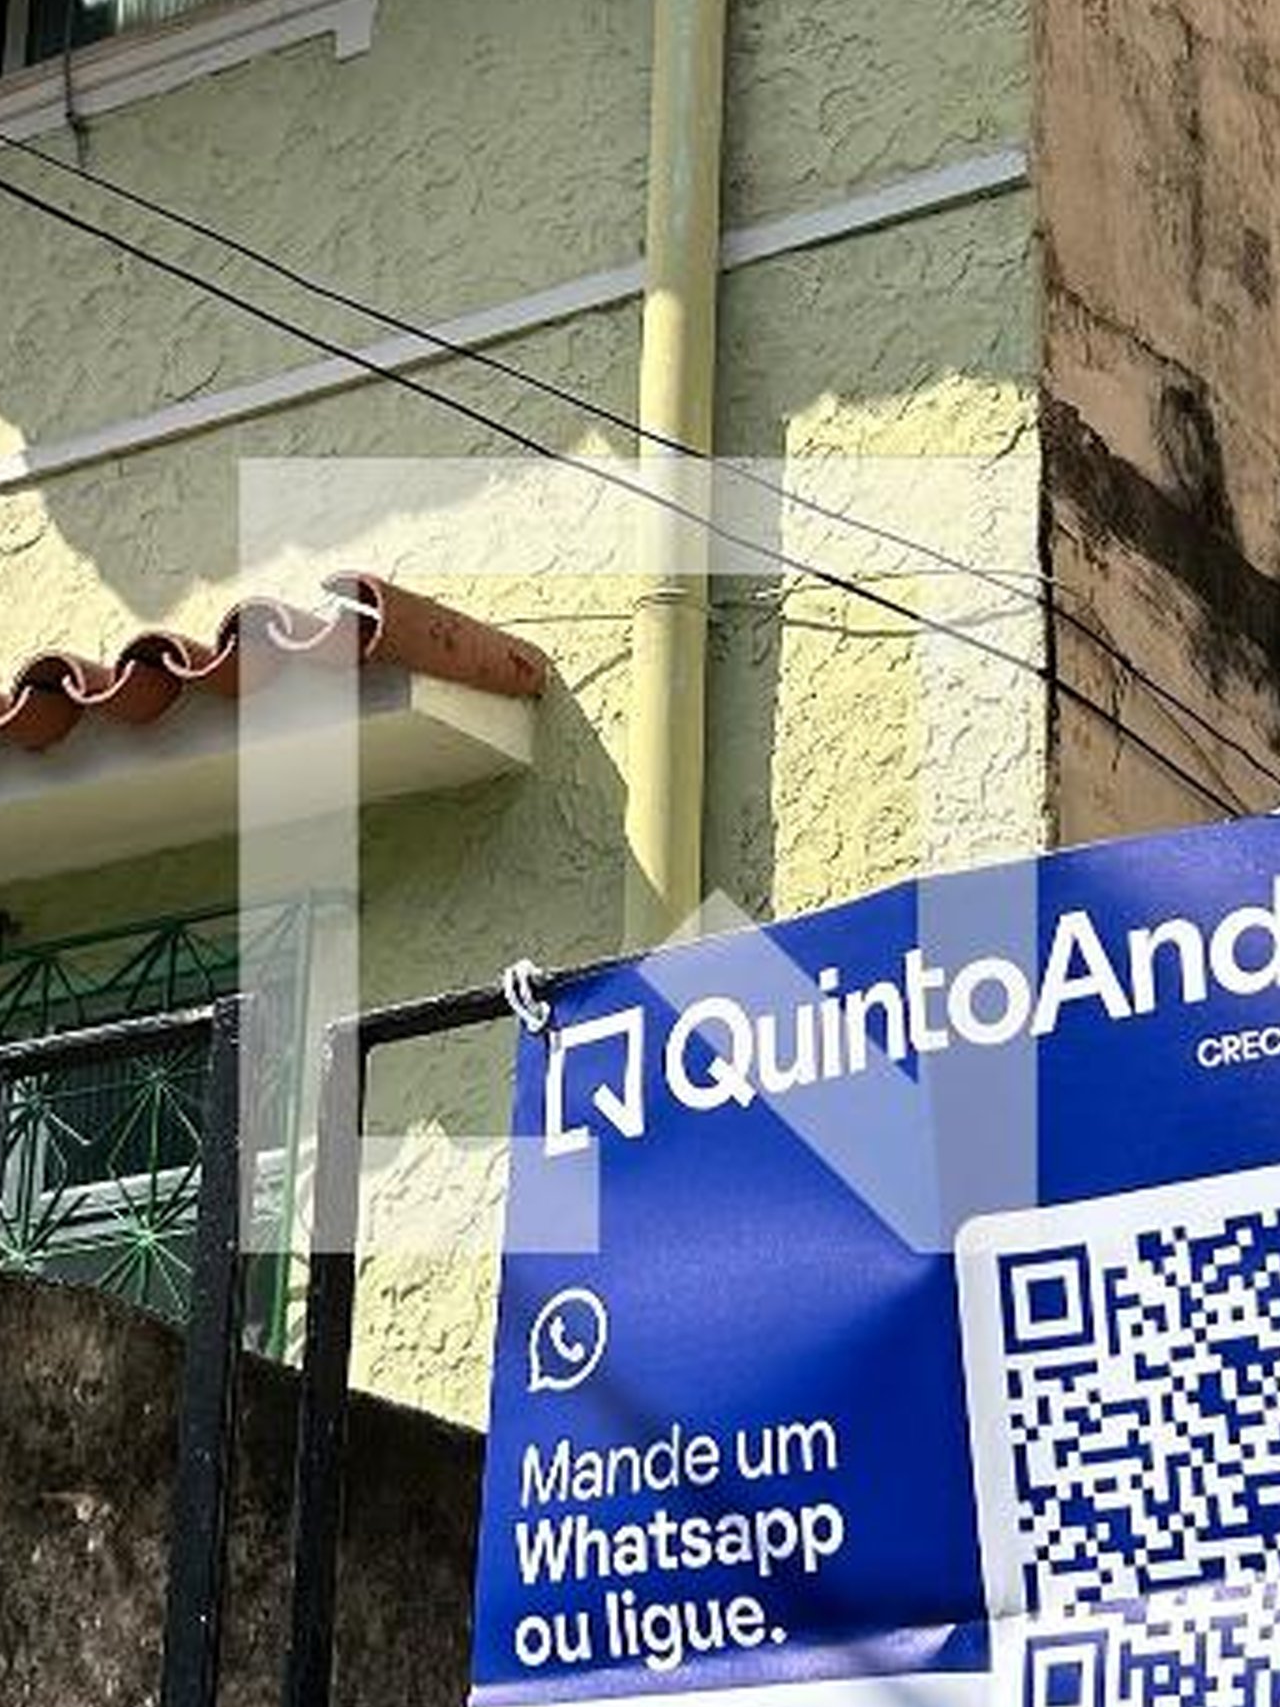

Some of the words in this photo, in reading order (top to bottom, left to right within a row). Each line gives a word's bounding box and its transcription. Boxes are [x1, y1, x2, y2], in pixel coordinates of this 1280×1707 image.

[521, 1422, 720, 1508] Mande
[736, 1420, 838, 1480] um
[515, 1503, 845, 1585] Whatsapp
[515, 1612, 591, 1666] ou
[605, 1589, 787, 1672] ligue.
